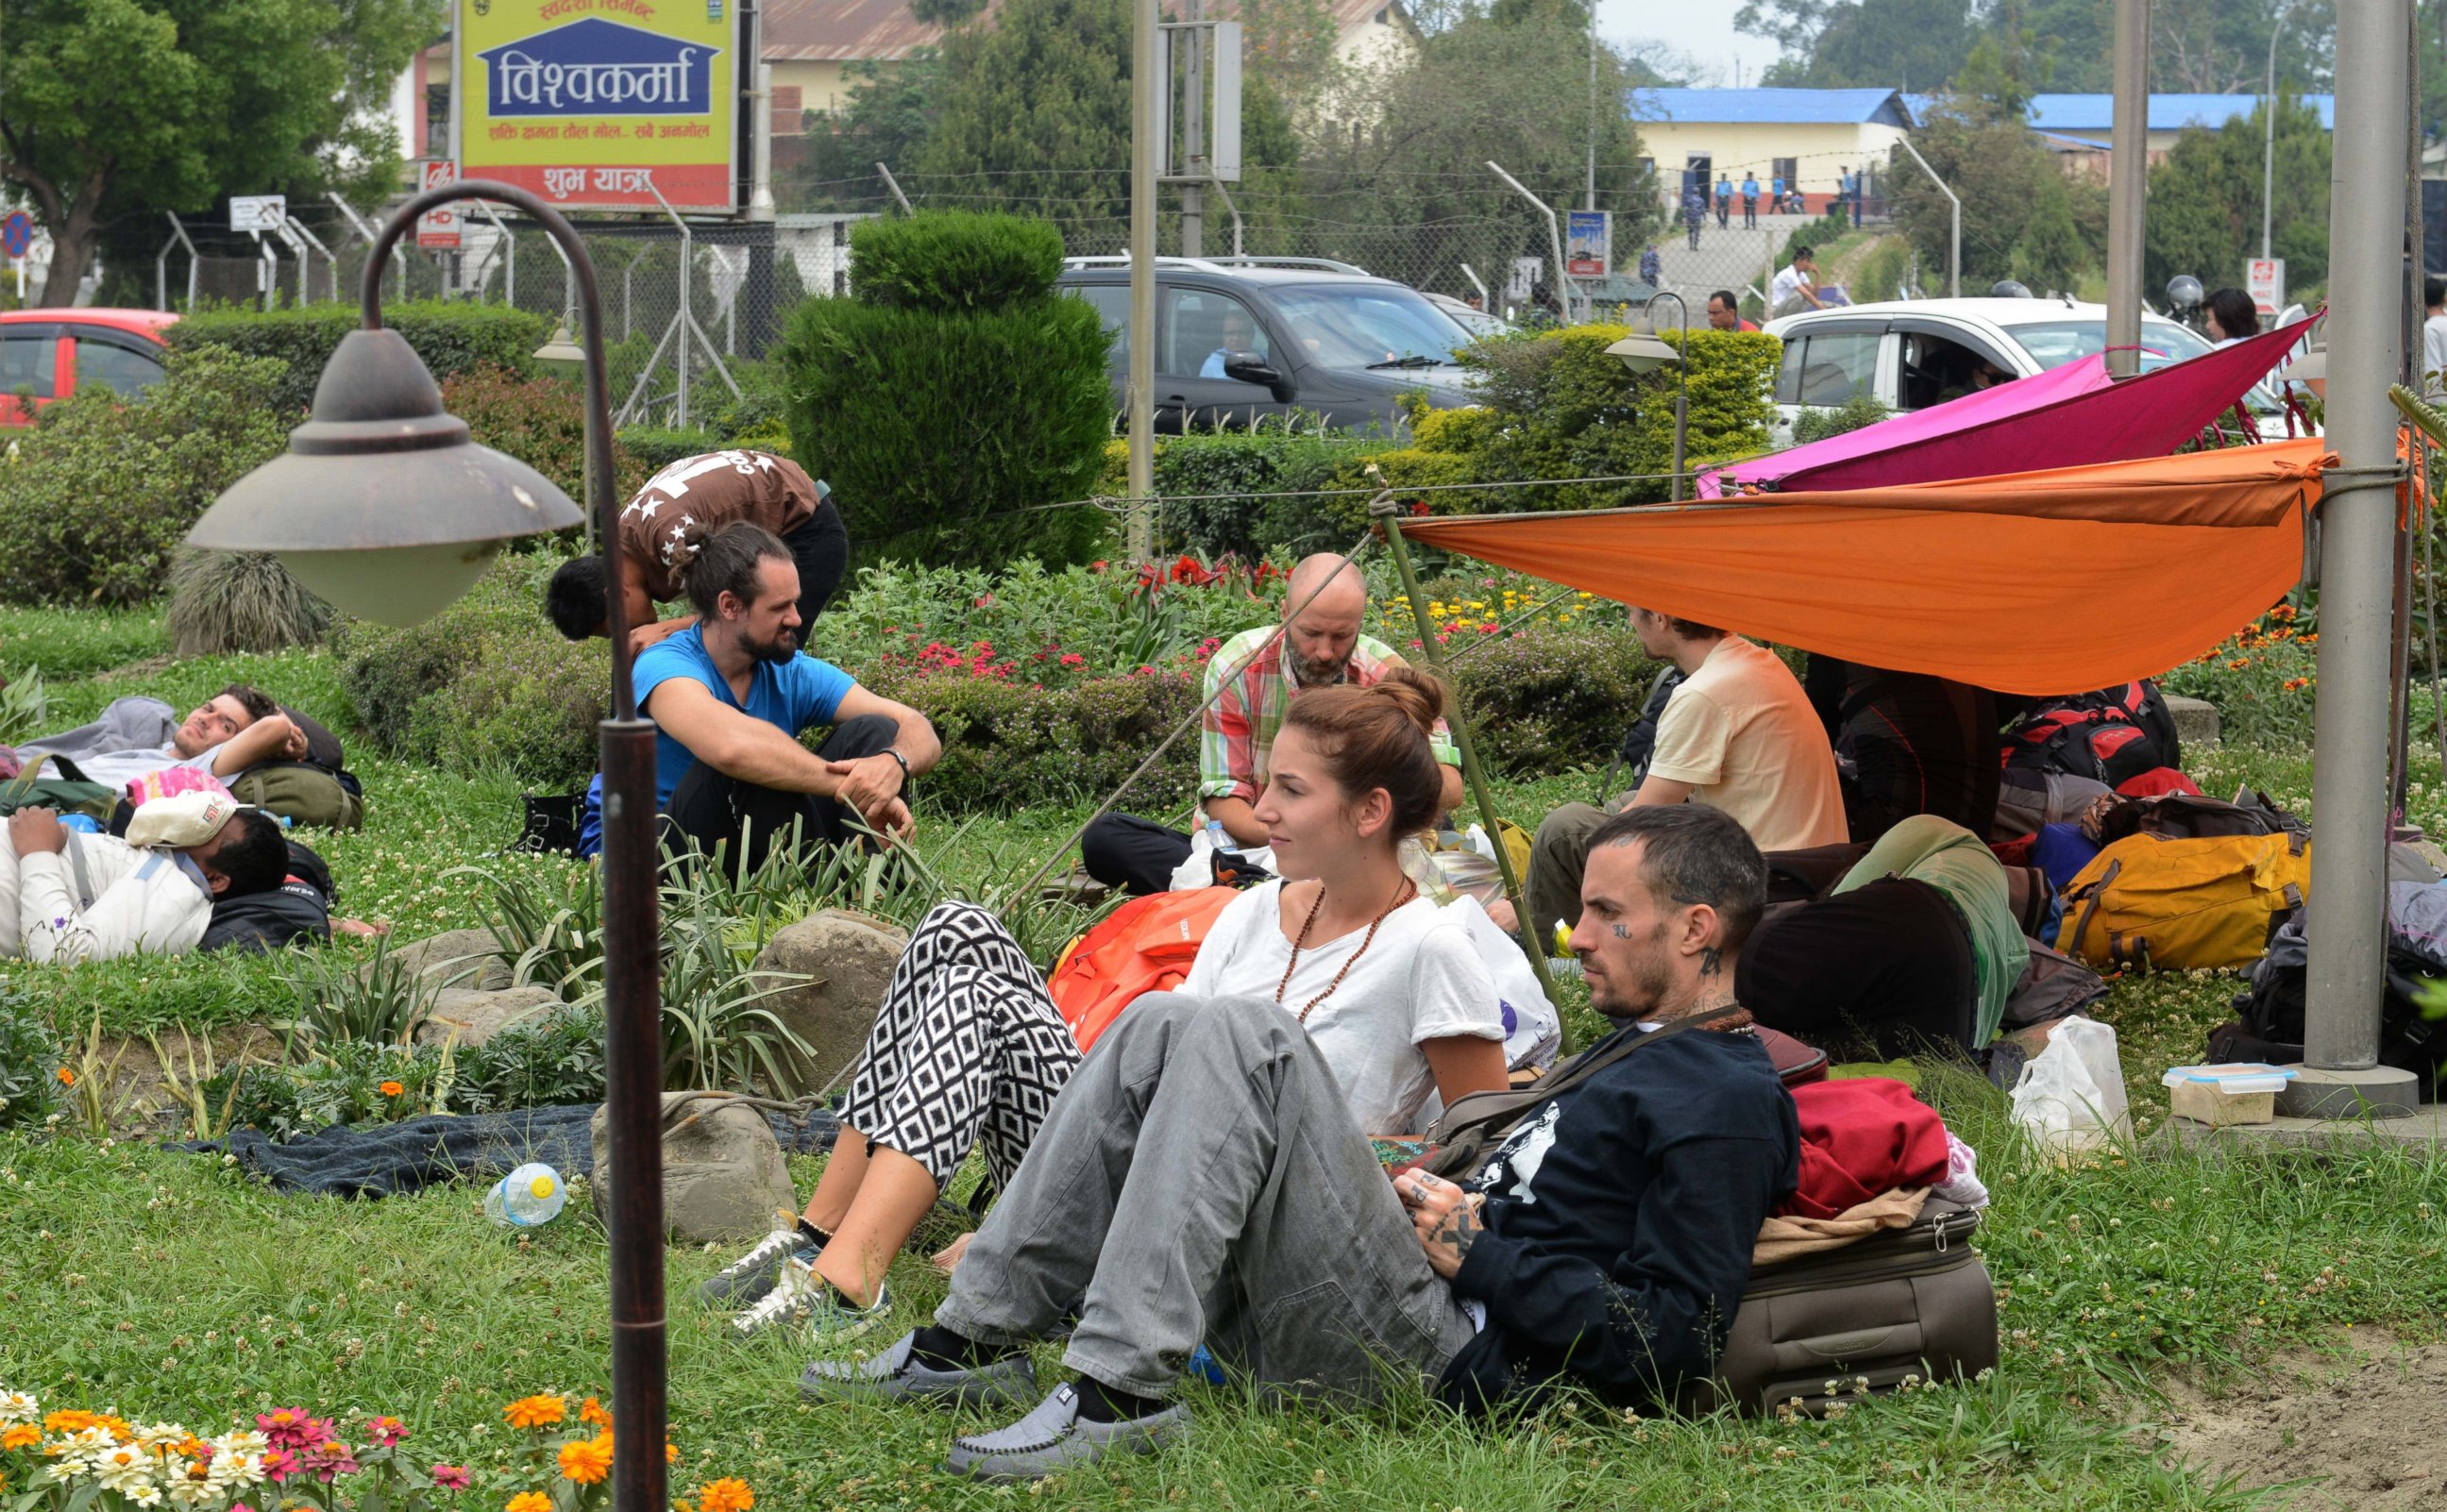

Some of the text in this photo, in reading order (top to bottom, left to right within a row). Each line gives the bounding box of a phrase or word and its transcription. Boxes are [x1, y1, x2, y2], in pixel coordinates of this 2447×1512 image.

[498, 48, 697, 108] विश्वकर्मा
[544, 168, 652, 199] शुभ यात्रा
